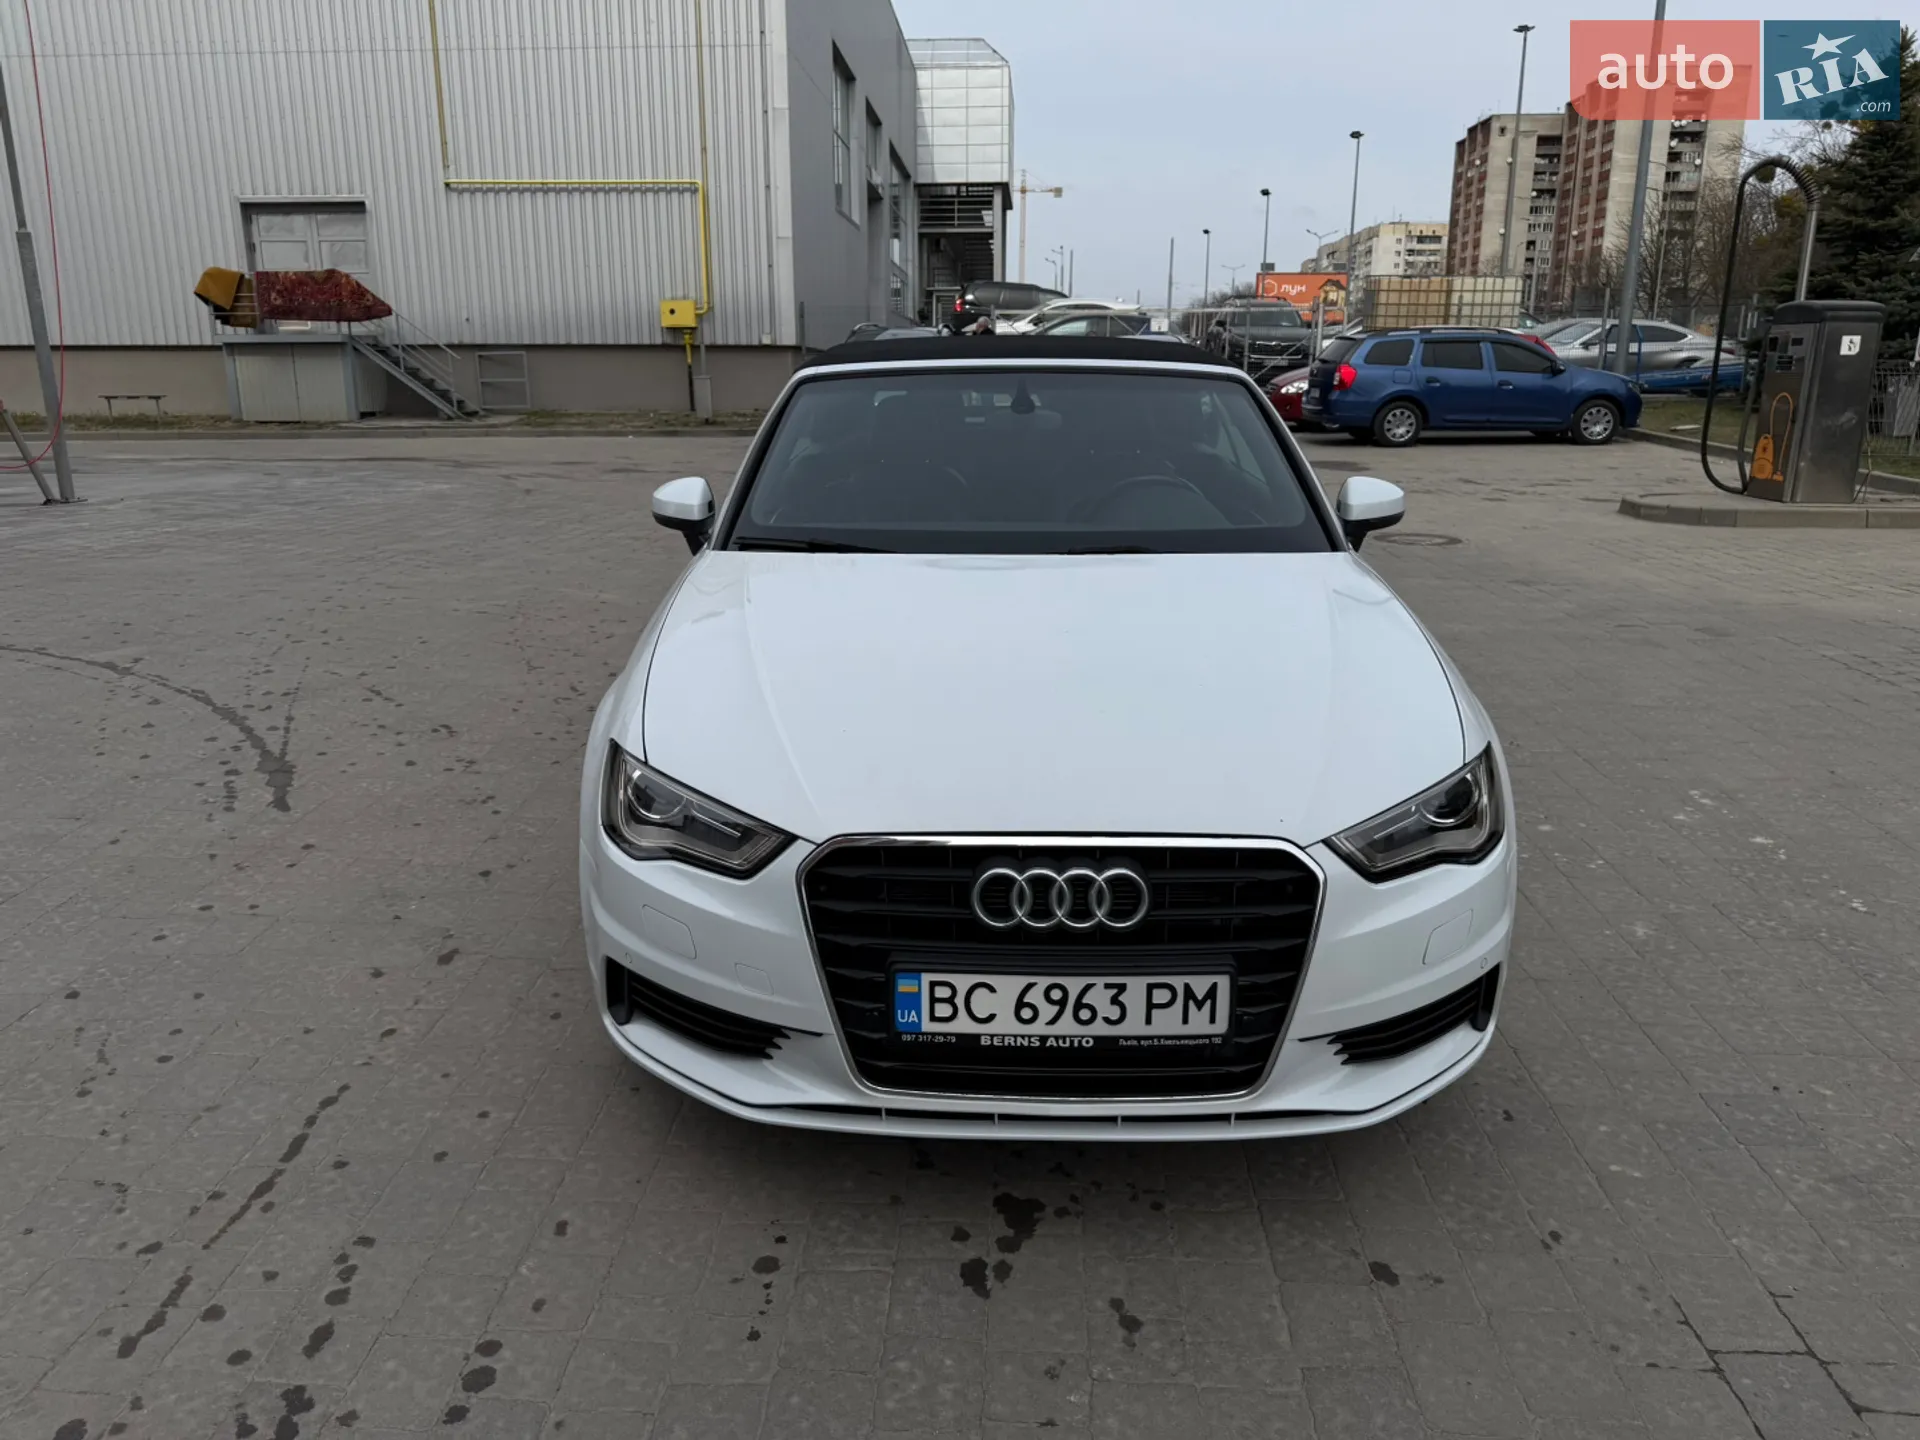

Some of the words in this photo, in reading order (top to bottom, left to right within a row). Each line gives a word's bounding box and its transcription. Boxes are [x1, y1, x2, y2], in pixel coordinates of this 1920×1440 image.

[928, 979, 998, 1024] BC
[1013, 981, 1128, 1026] 6963
[1145, 980, 1219, 1026] PM
[897, 1009, 919, 1023] UA
[980, 1034, 1041, 1047] BERNS
[1045, 1036, 1094, 1048] AUTO
